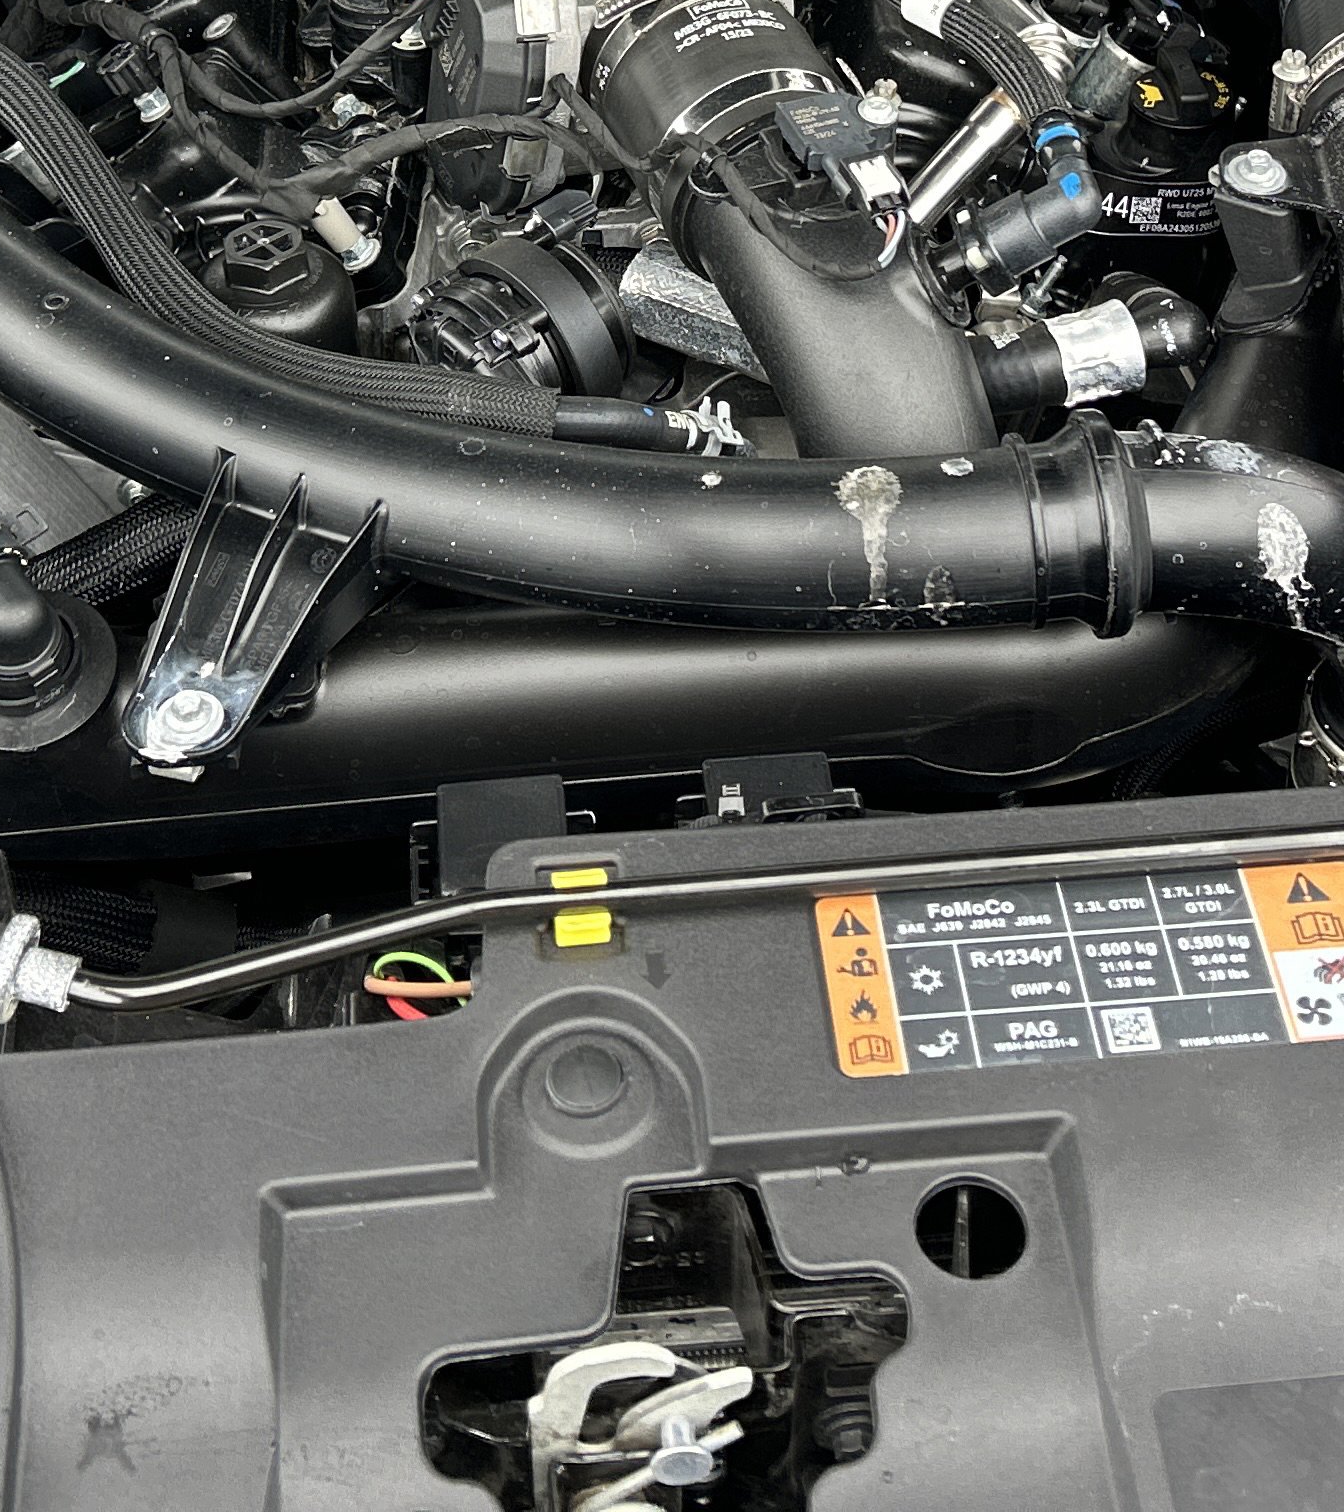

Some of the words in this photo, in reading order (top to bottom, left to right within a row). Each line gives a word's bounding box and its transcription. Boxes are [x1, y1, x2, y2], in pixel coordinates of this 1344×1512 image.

[1157, 188, 1181, 198] RWD
[1101, 192, 1129, 219] 44
[926, 898, 1015, 919] FoMoCo
[1108, 897, 1146, 911] GTDI
[1184, 900, 1222, 914] GTDI
[896, 922, 926, 935] SAE
[1085, 941, 1132, 958] 0.600
[1135, 940, 1158, 956] kg
[1227, 933, 1251, 950] kg
[970, 945, 1063, 968] R-1234yf
[1133, 975, 1157, 987] lbs
[1227, 968, 1251, 979] lbs
[1010, 982, 1052, 999] (GWP
[1055, 980, 1072, 995] 4)
[1008, 1020, 1058, 1039] PAG
